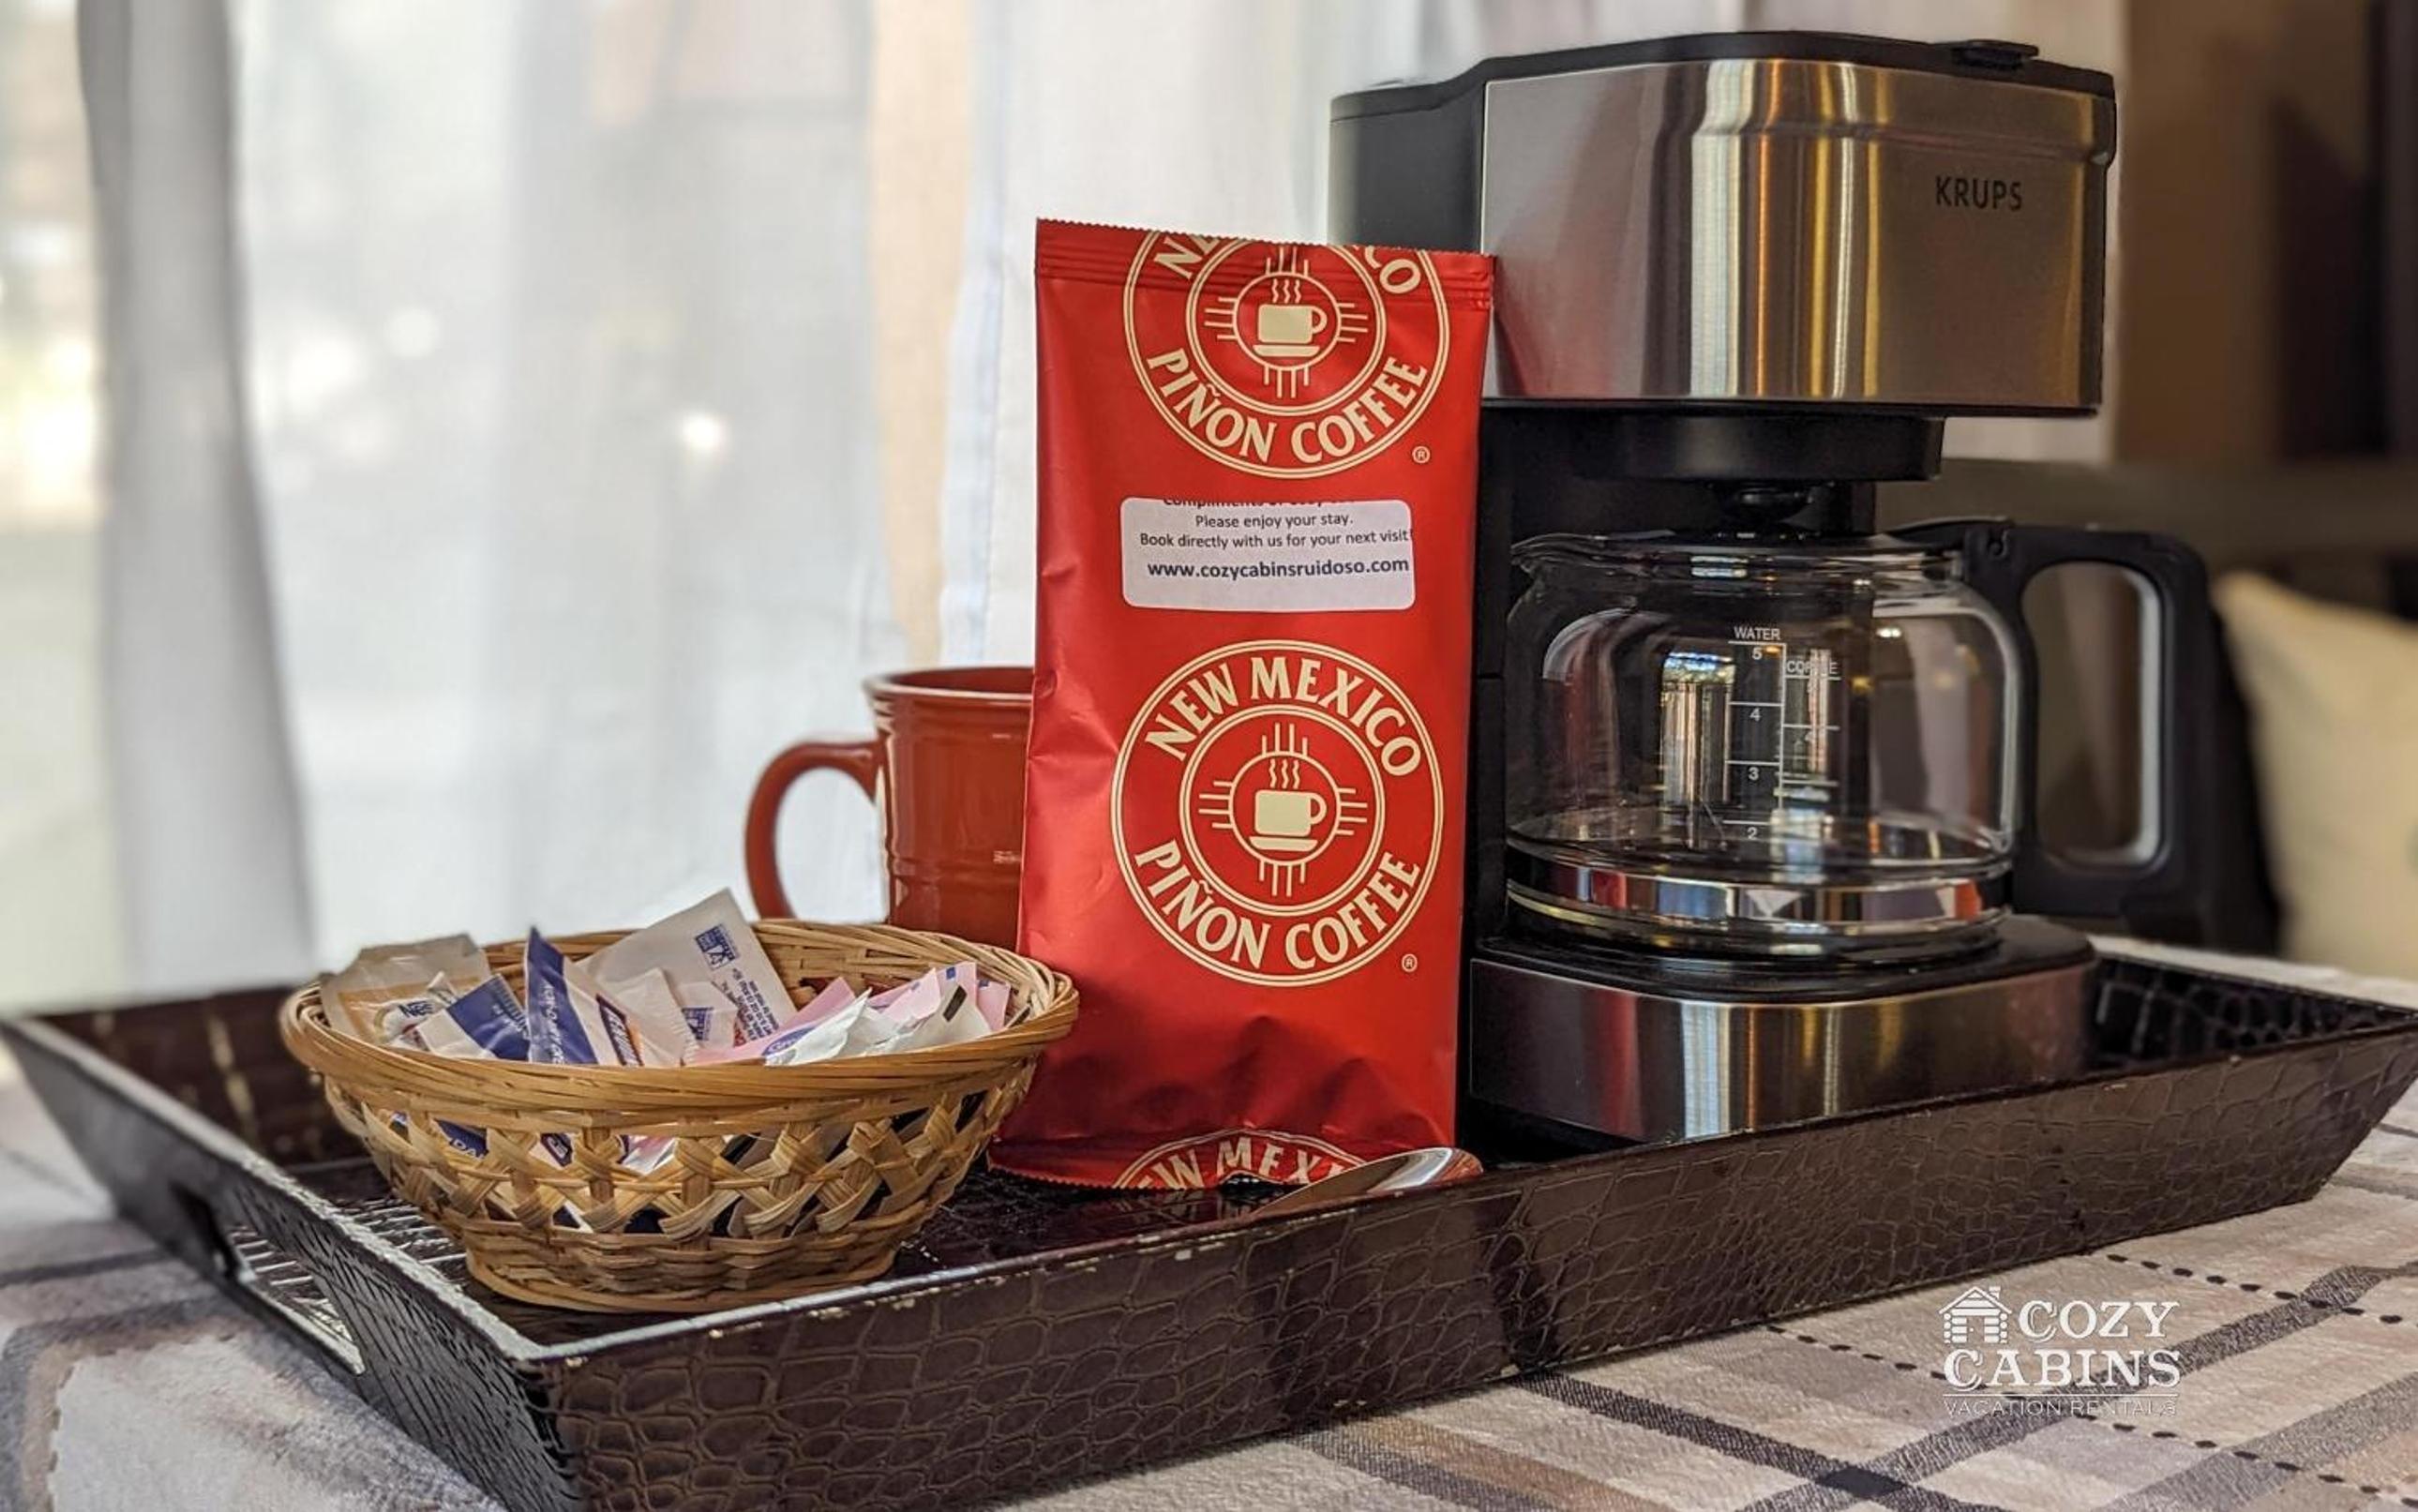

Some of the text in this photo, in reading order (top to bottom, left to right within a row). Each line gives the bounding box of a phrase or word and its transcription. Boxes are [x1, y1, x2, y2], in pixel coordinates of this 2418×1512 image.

[1935, 176, 2022, 212] KRUPS
[1147, 348, 1426, 463] PIÑON COFFEE
[1195, 512, 1354, 531] Please enjoy your stay.
[1140, 532, 1174, 546] Book
[1178, 532, 1227, 550] directly
[1232, 534, 1263, 548] with
[1267, 535, 1284, 547] us
[1286, 532, 1306, 546] for
[1310, 533, 1342, 549] your
[1345, 530, 1377, 545] next
[1148, 558, 1410, 580] www.cozycabinsruidoso.com
[1734, 626, 1780, 640] WATER
[1752, 647, 1762, 660] 5
[1145, 656, 1421, 777] NEW MEXICO
[1750, 709, 1761, 721] 4
[1749, 767, 1759, 780] 3
[1747, 828, 1757, 840] 2
[1134, 839, 1421, 970] PIÑON COFFEE
